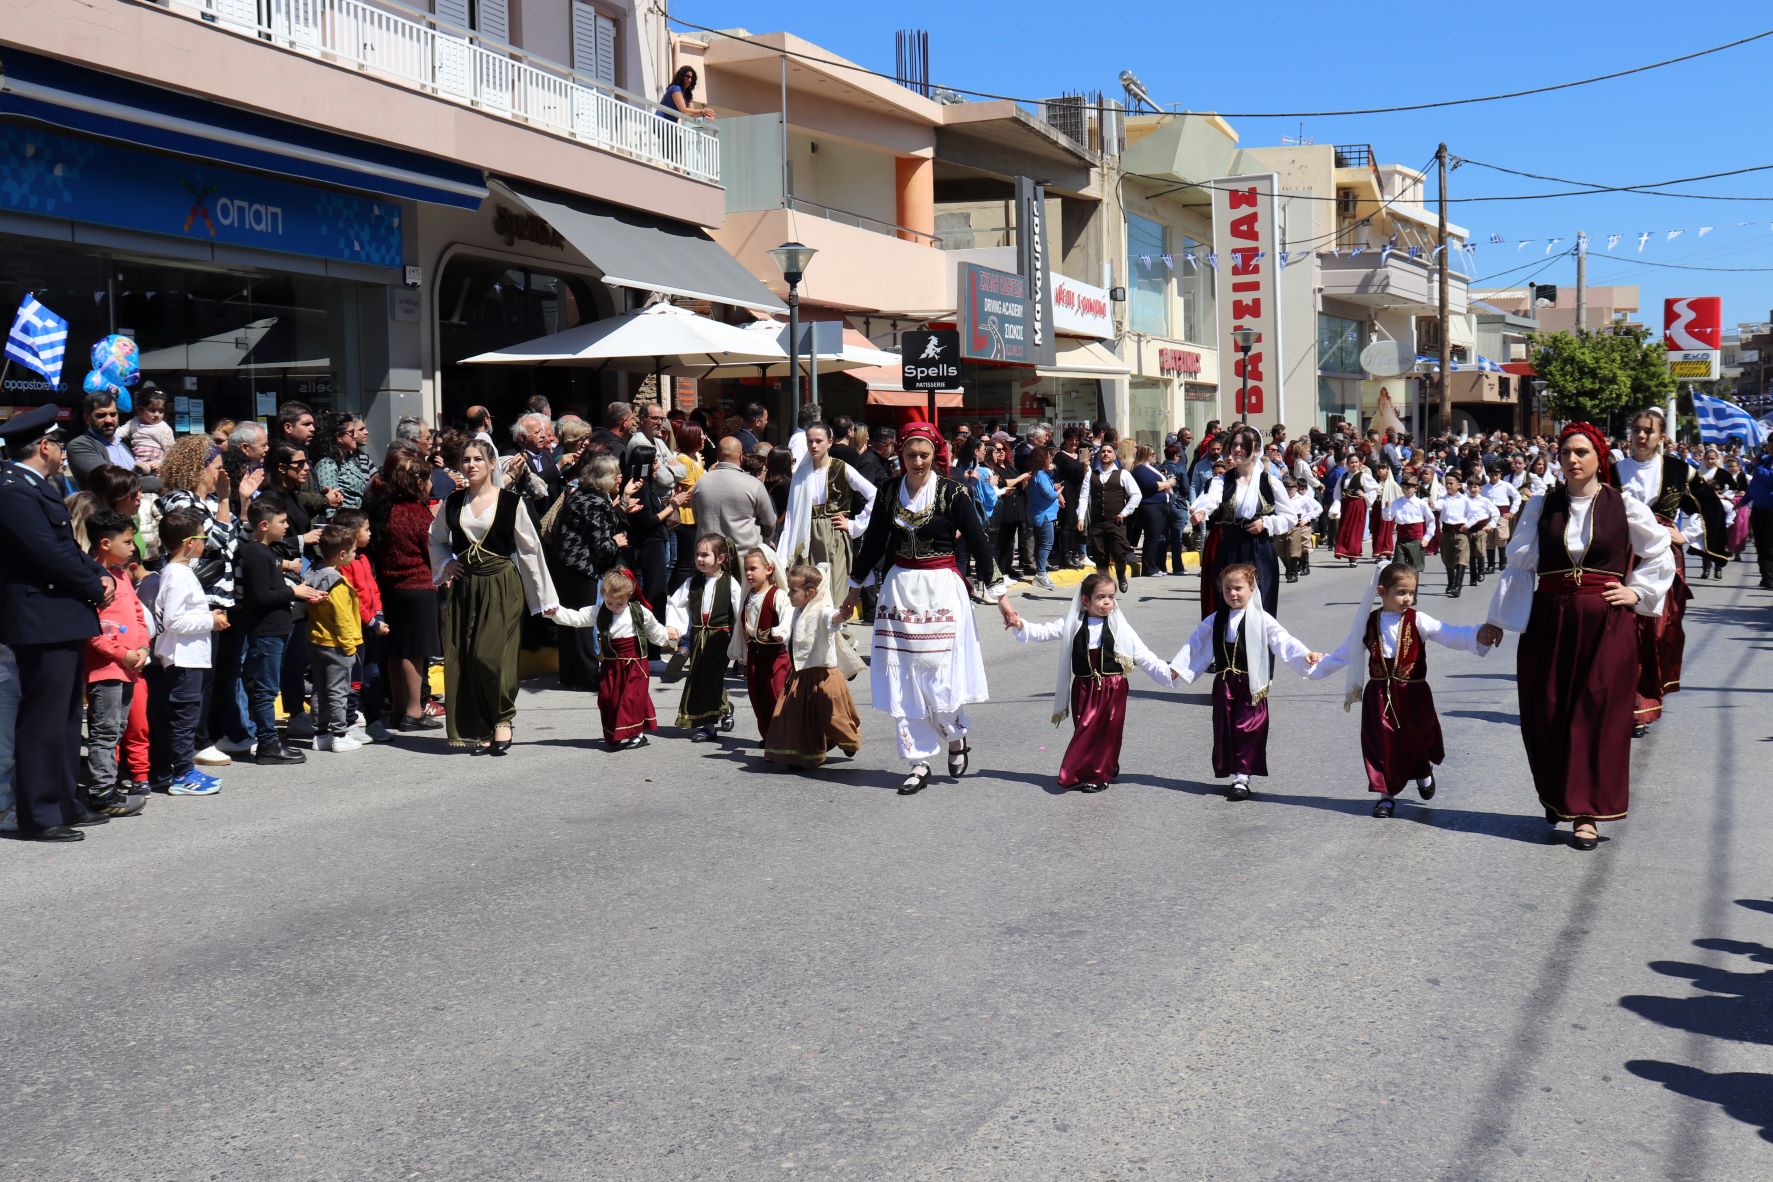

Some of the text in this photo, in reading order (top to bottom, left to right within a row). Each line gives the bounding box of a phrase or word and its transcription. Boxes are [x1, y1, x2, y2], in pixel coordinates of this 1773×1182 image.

[984, 298, 1024, 318] DRIVING ACADEMY
[904, 363, 958, 380] Spells
